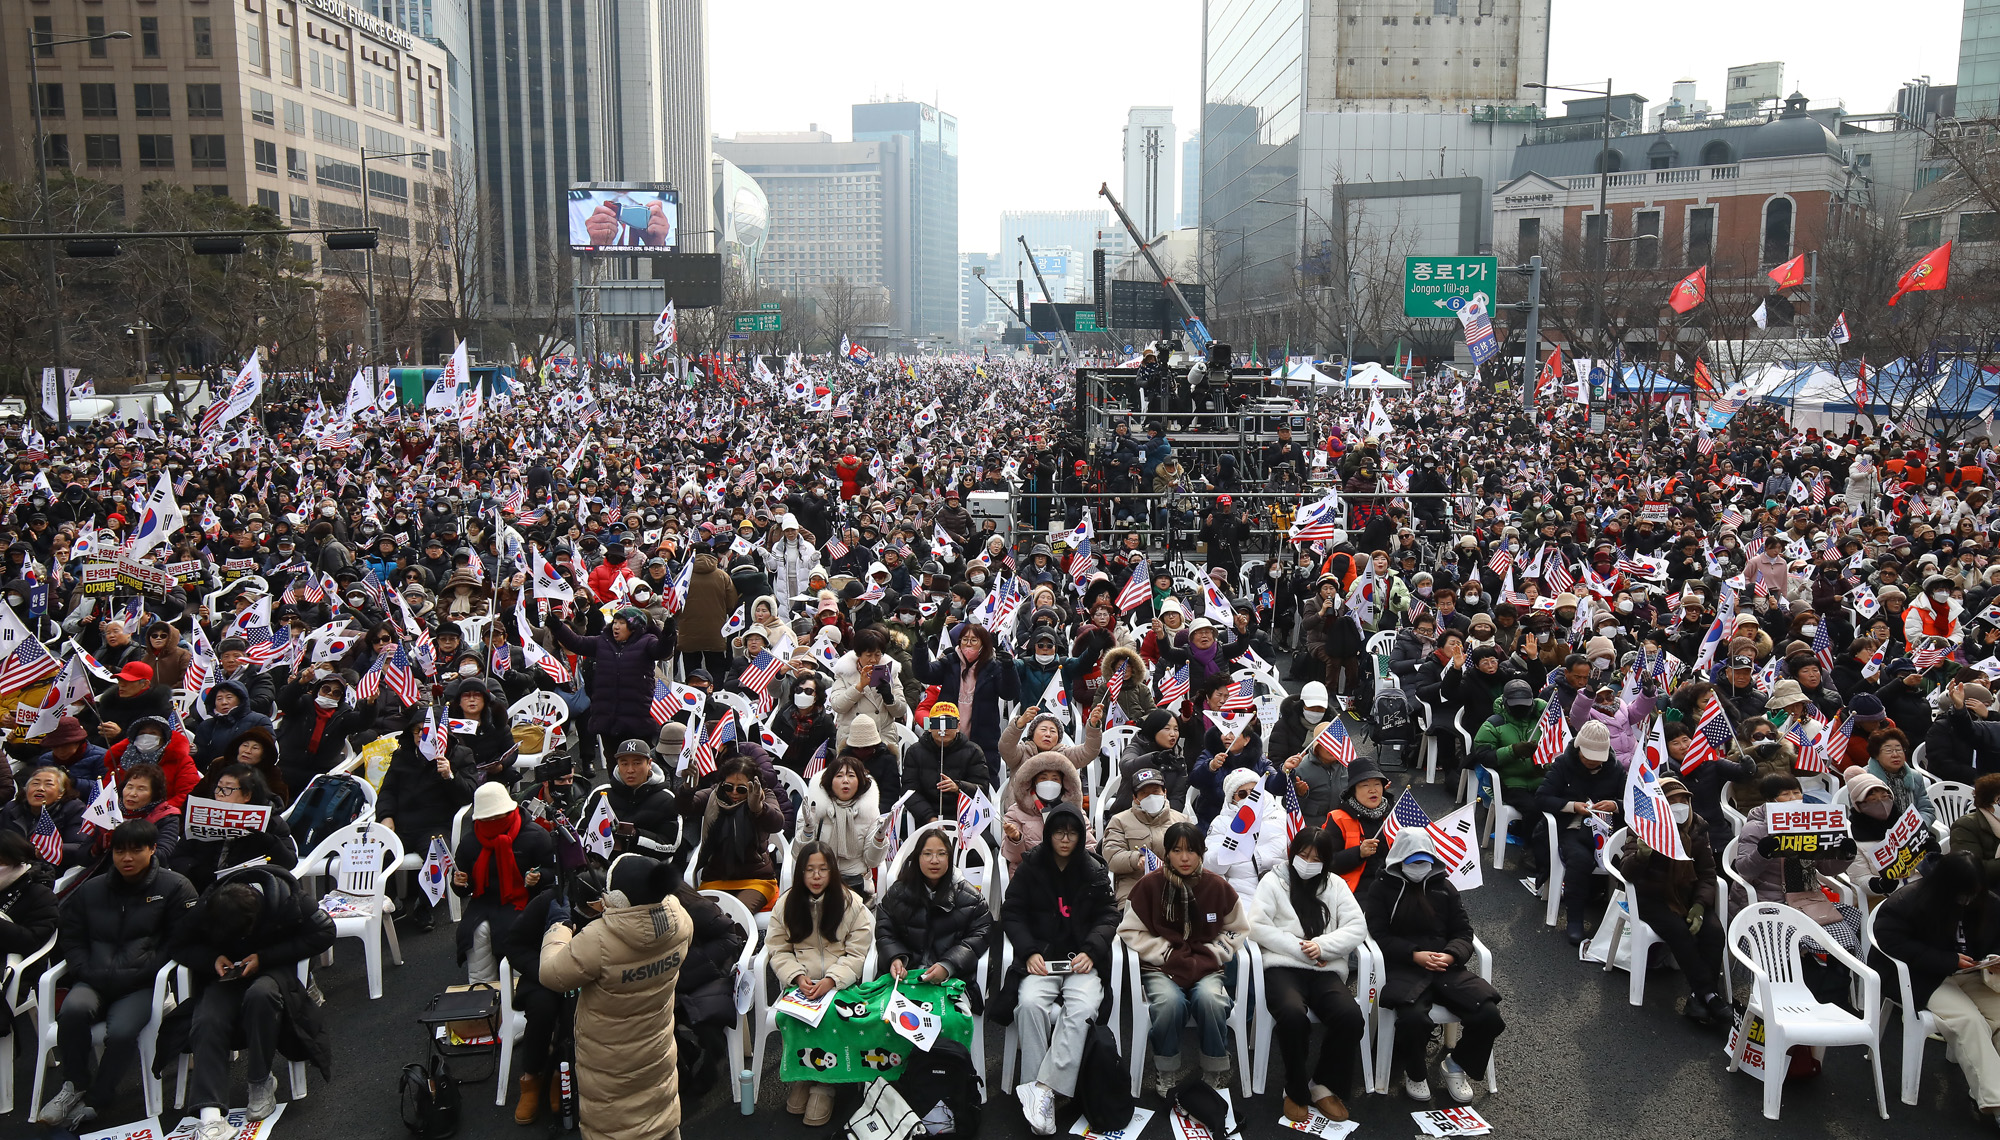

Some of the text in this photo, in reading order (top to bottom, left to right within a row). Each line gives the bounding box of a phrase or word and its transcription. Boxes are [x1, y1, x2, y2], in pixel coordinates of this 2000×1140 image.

[316, 0, 415, 51] SEOUL FINANCE CENTER
[1412, 262, 1488, 281] 종로1가
[1411, 283, 1470, 296] Jongno 1(il)-ga
[1452, 298, 1460, 309] 6
[118, 560, 163, 584] 탄핵무효
[167, 560, 201, 575] 탄핵무효
[85, 582, 116, 594] 이재명
[118, 573, 164, 595] 이재명 구속
[191, 806, 262, 830] 불법구속
[1772, 809, 1845, 831] 탄핵무효
[1873, 809, 1920, 867] 탄핵무효
